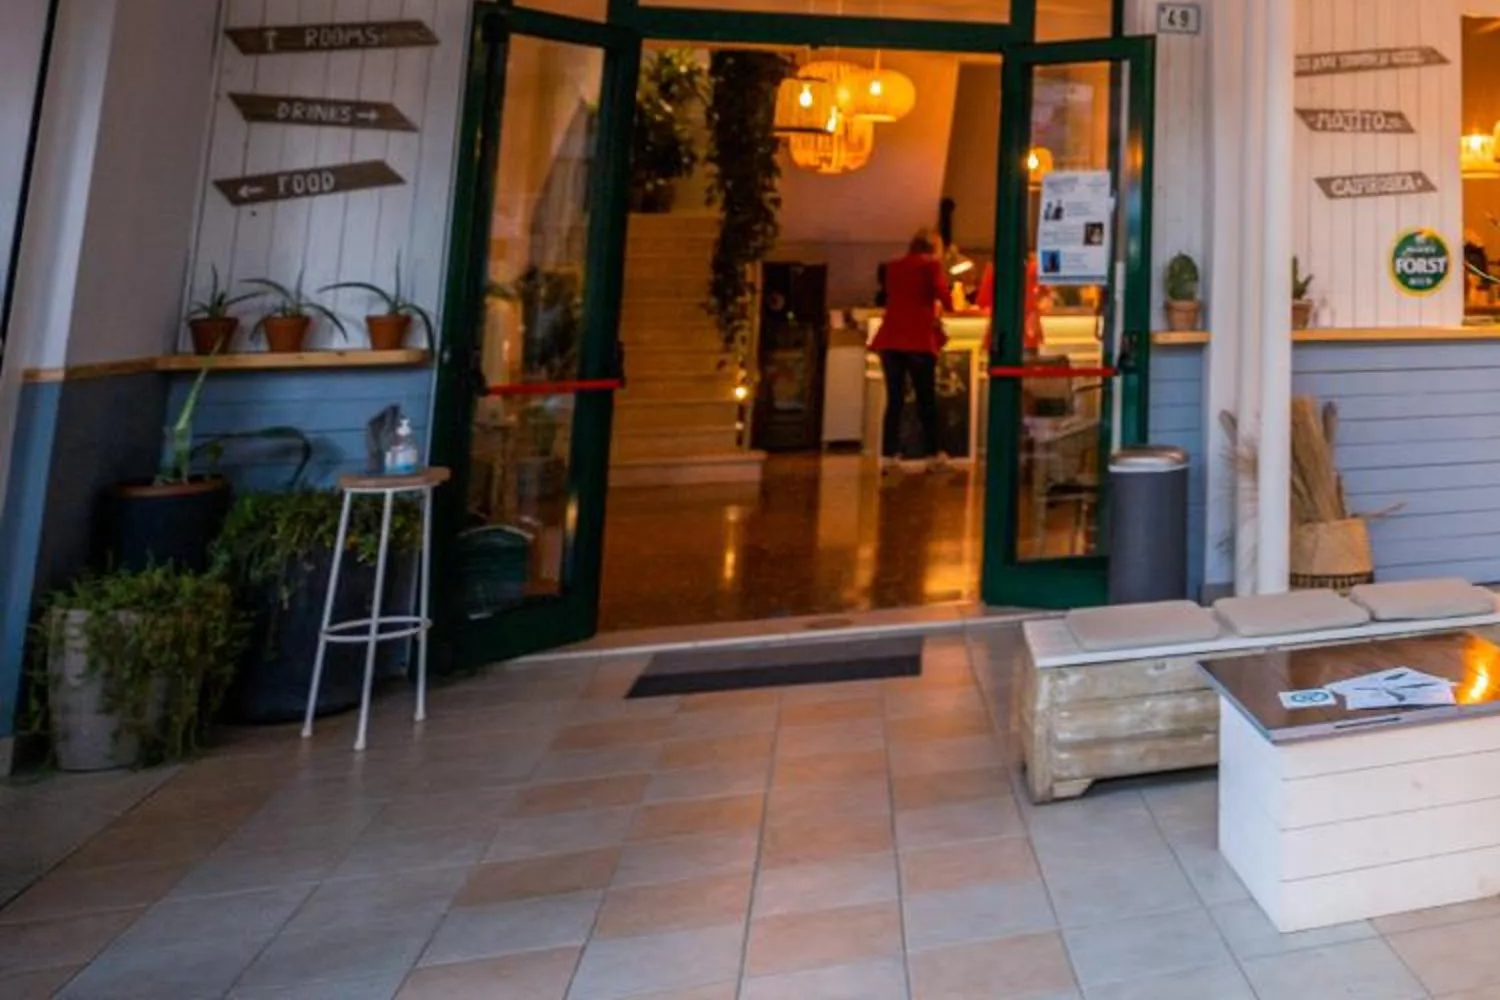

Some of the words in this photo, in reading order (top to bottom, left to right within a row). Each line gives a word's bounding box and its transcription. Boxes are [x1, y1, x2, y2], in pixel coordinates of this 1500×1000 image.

[304, 27, 380, 48] ROOMS
[276, 103, 352, 123] DRINKS
[277, 171, 335, 194] FOOD
[1395, 257, 1447, 274] FORST
